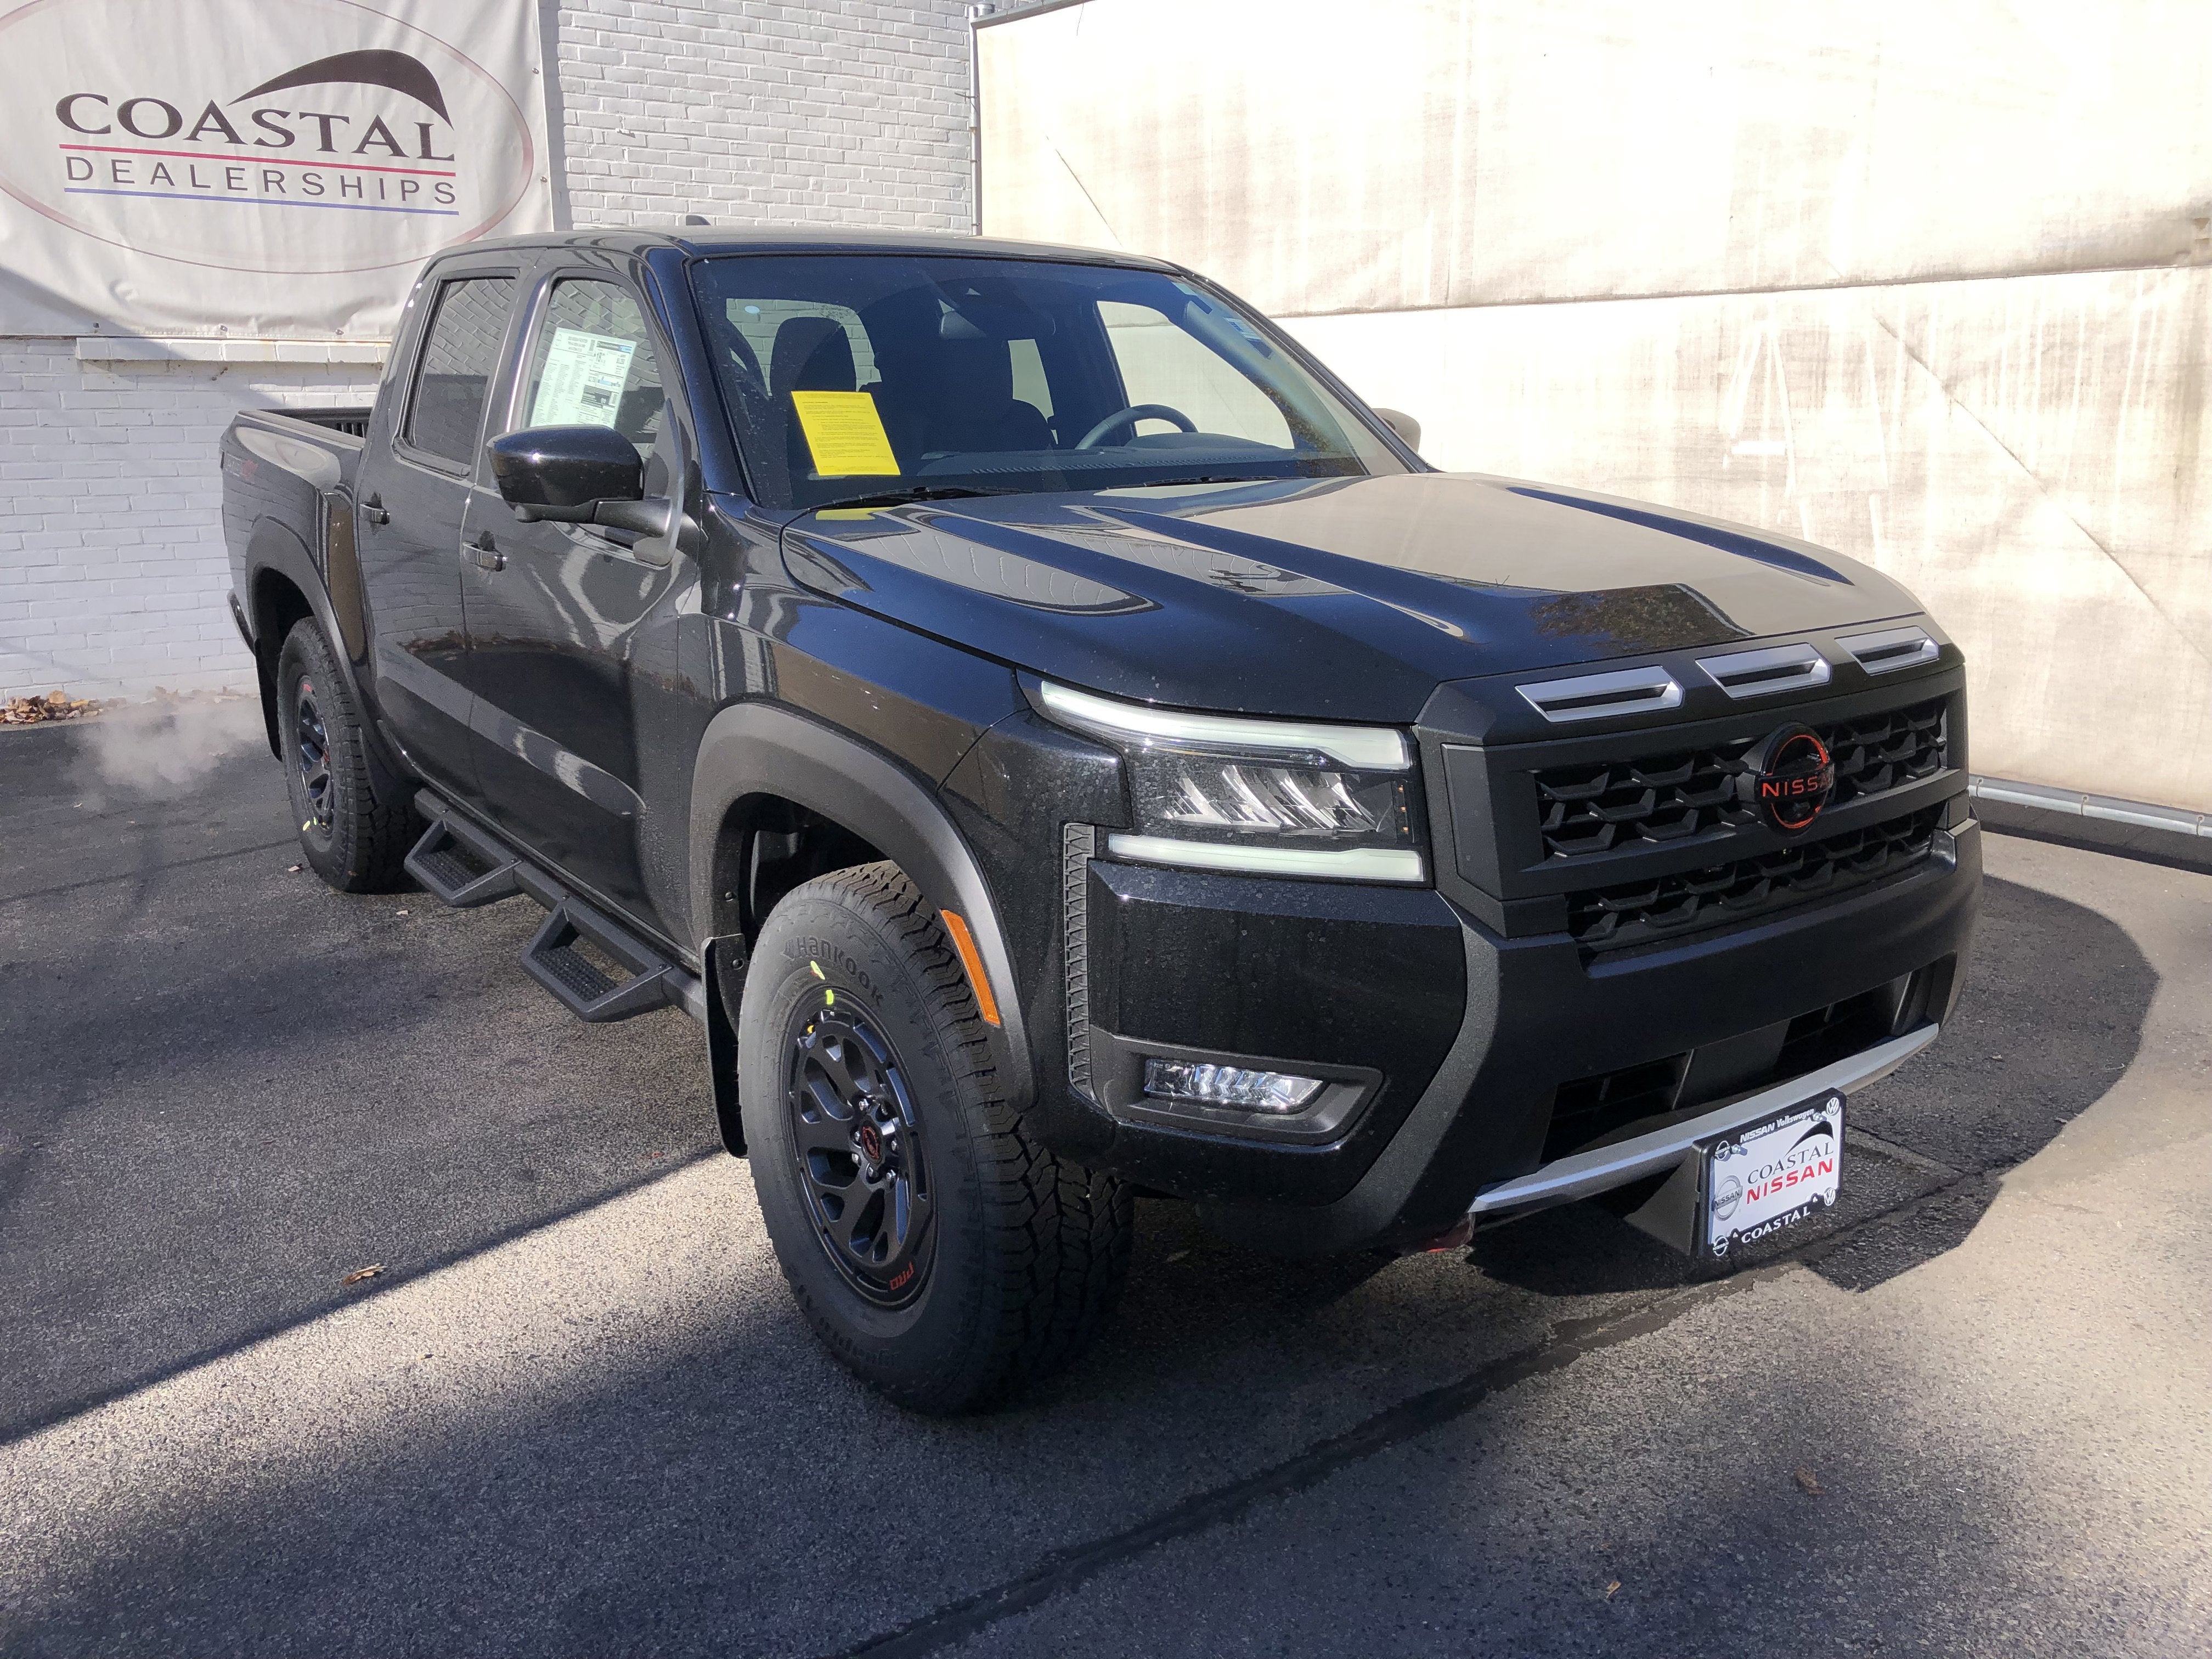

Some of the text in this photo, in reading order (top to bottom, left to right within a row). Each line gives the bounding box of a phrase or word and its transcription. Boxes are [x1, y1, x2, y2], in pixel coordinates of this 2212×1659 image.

[55, 93, 455, 162] COASTAL
[66, 156, 456, 205] DEALERSHIPS
[1762, 772, 1831, 797] NISS
[1740, 1108, 1814, 1143] NISSAN Volkswagen
[1747, 1142, 1834, 1184] COASTAL
[1747, 1158, 1833, 1205] NISSAN
[1714, 1189, 1740, 1207] NISSAN
[1741, 1206, 1810, 1244] COASTAL
